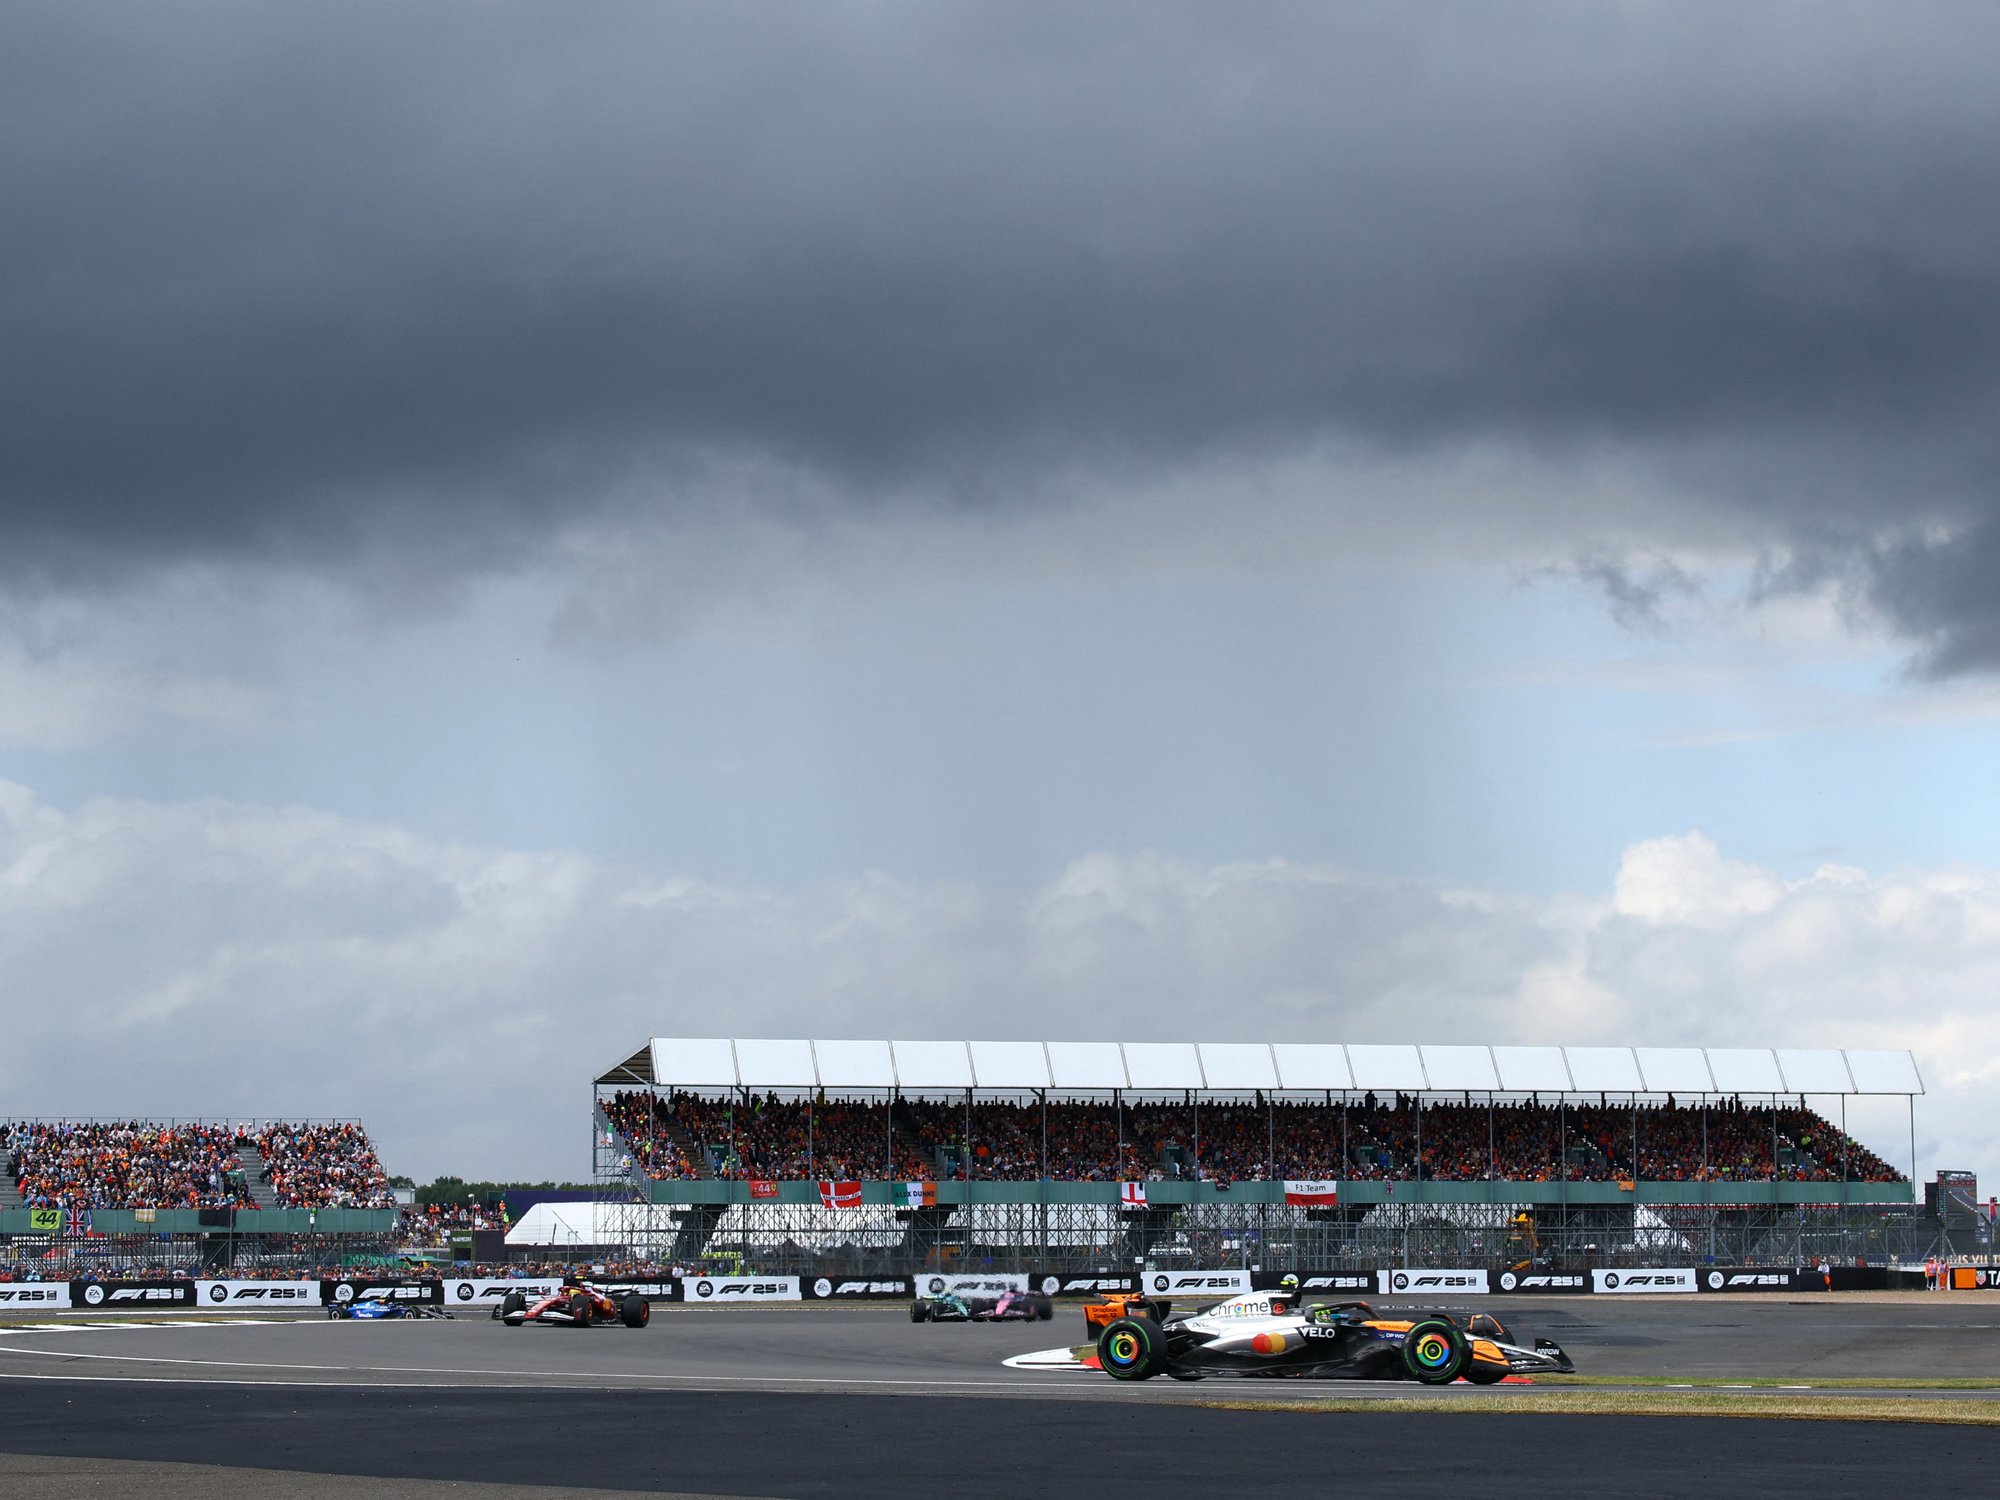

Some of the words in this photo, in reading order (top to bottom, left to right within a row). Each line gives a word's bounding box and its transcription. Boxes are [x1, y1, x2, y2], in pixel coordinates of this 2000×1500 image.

[758, 1184, 771, 1193] 44
[1295, 1184, 1304, 1192] F1
[1305, 1184, 1327, 1192] Team
[35, 1210, 57, 1225] 44
[1206, 1278, 1230, 1287] 25
[1335, 1277, 1359, 1288] 25
[1444, 1277, 1466, 1286] 25
[1550, 1276, 1573, 1286] 25
[1654, 1276, 1676, 1285] 25
[1757, 1275, 1780, 1285] 25
[394, 1288, 420, 1298] 25
[752, 1283, 777, 1293] 25
[18, 1290, 45, 1301] 25
[145, 1288, 173, 1299] 25
[269, 1288, 296, 1299] 25
[1208, 1301, 1269, 1316] Chrome
[1299, 1327, 1336, 1339] VELO
